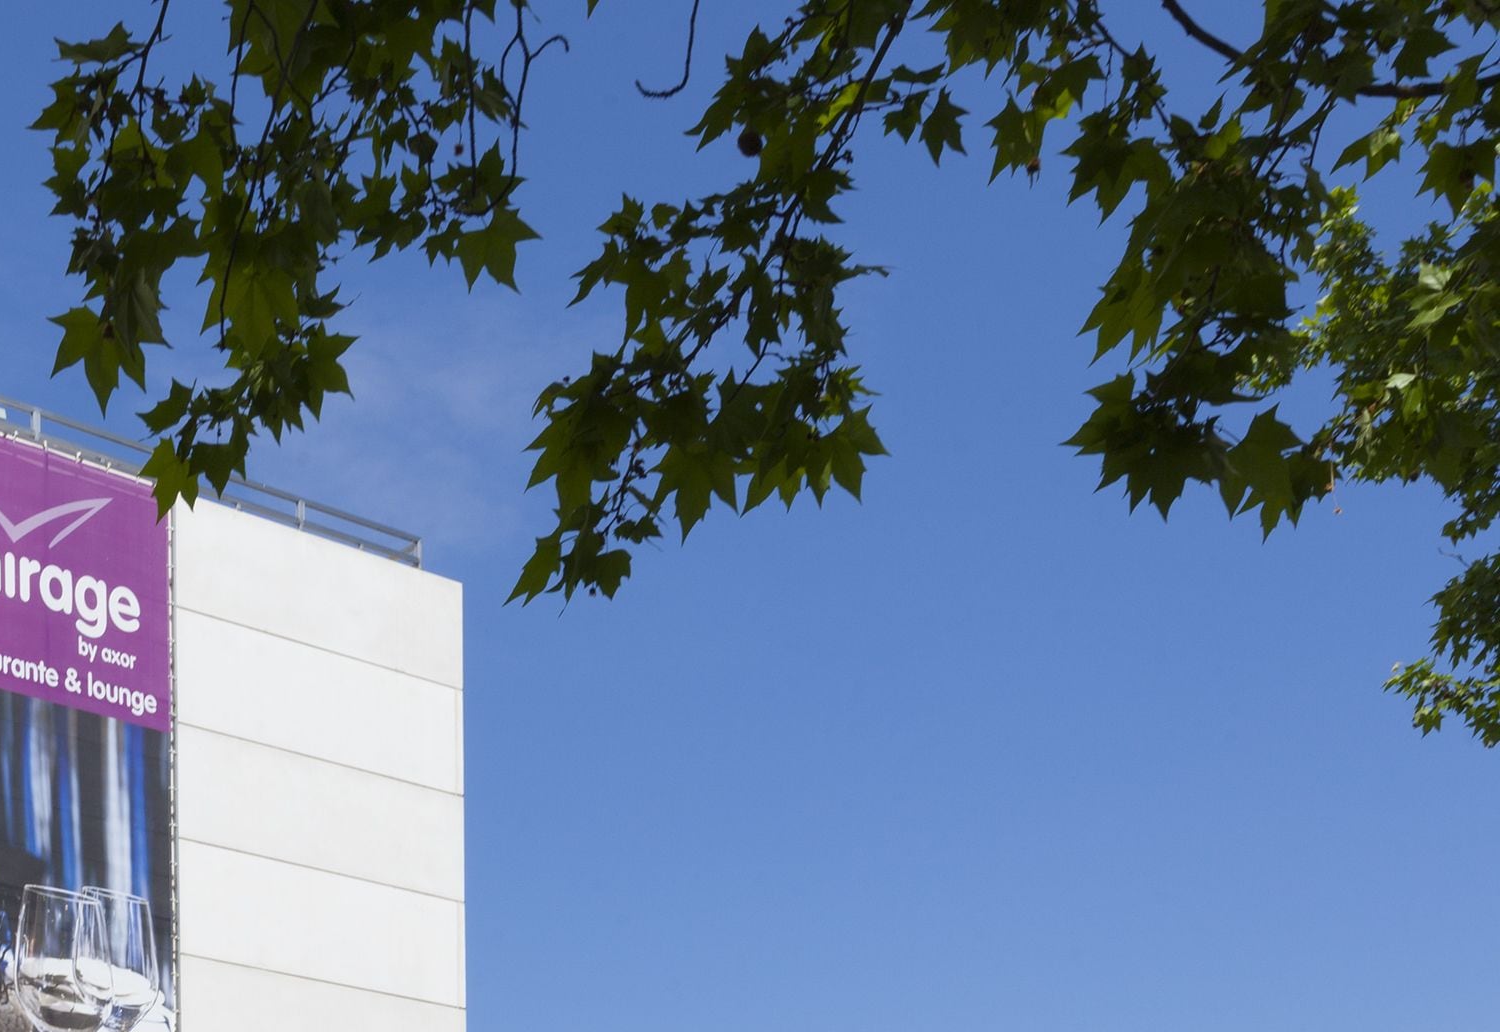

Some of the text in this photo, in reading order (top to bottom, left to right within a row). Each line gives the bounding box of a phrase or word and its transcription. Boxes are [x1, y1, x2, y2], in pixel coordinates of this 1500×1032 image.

[78, 635, 137, 669] by axor
[64, 667, 82, 694] &
[87, 671, 158, 717] lounge
